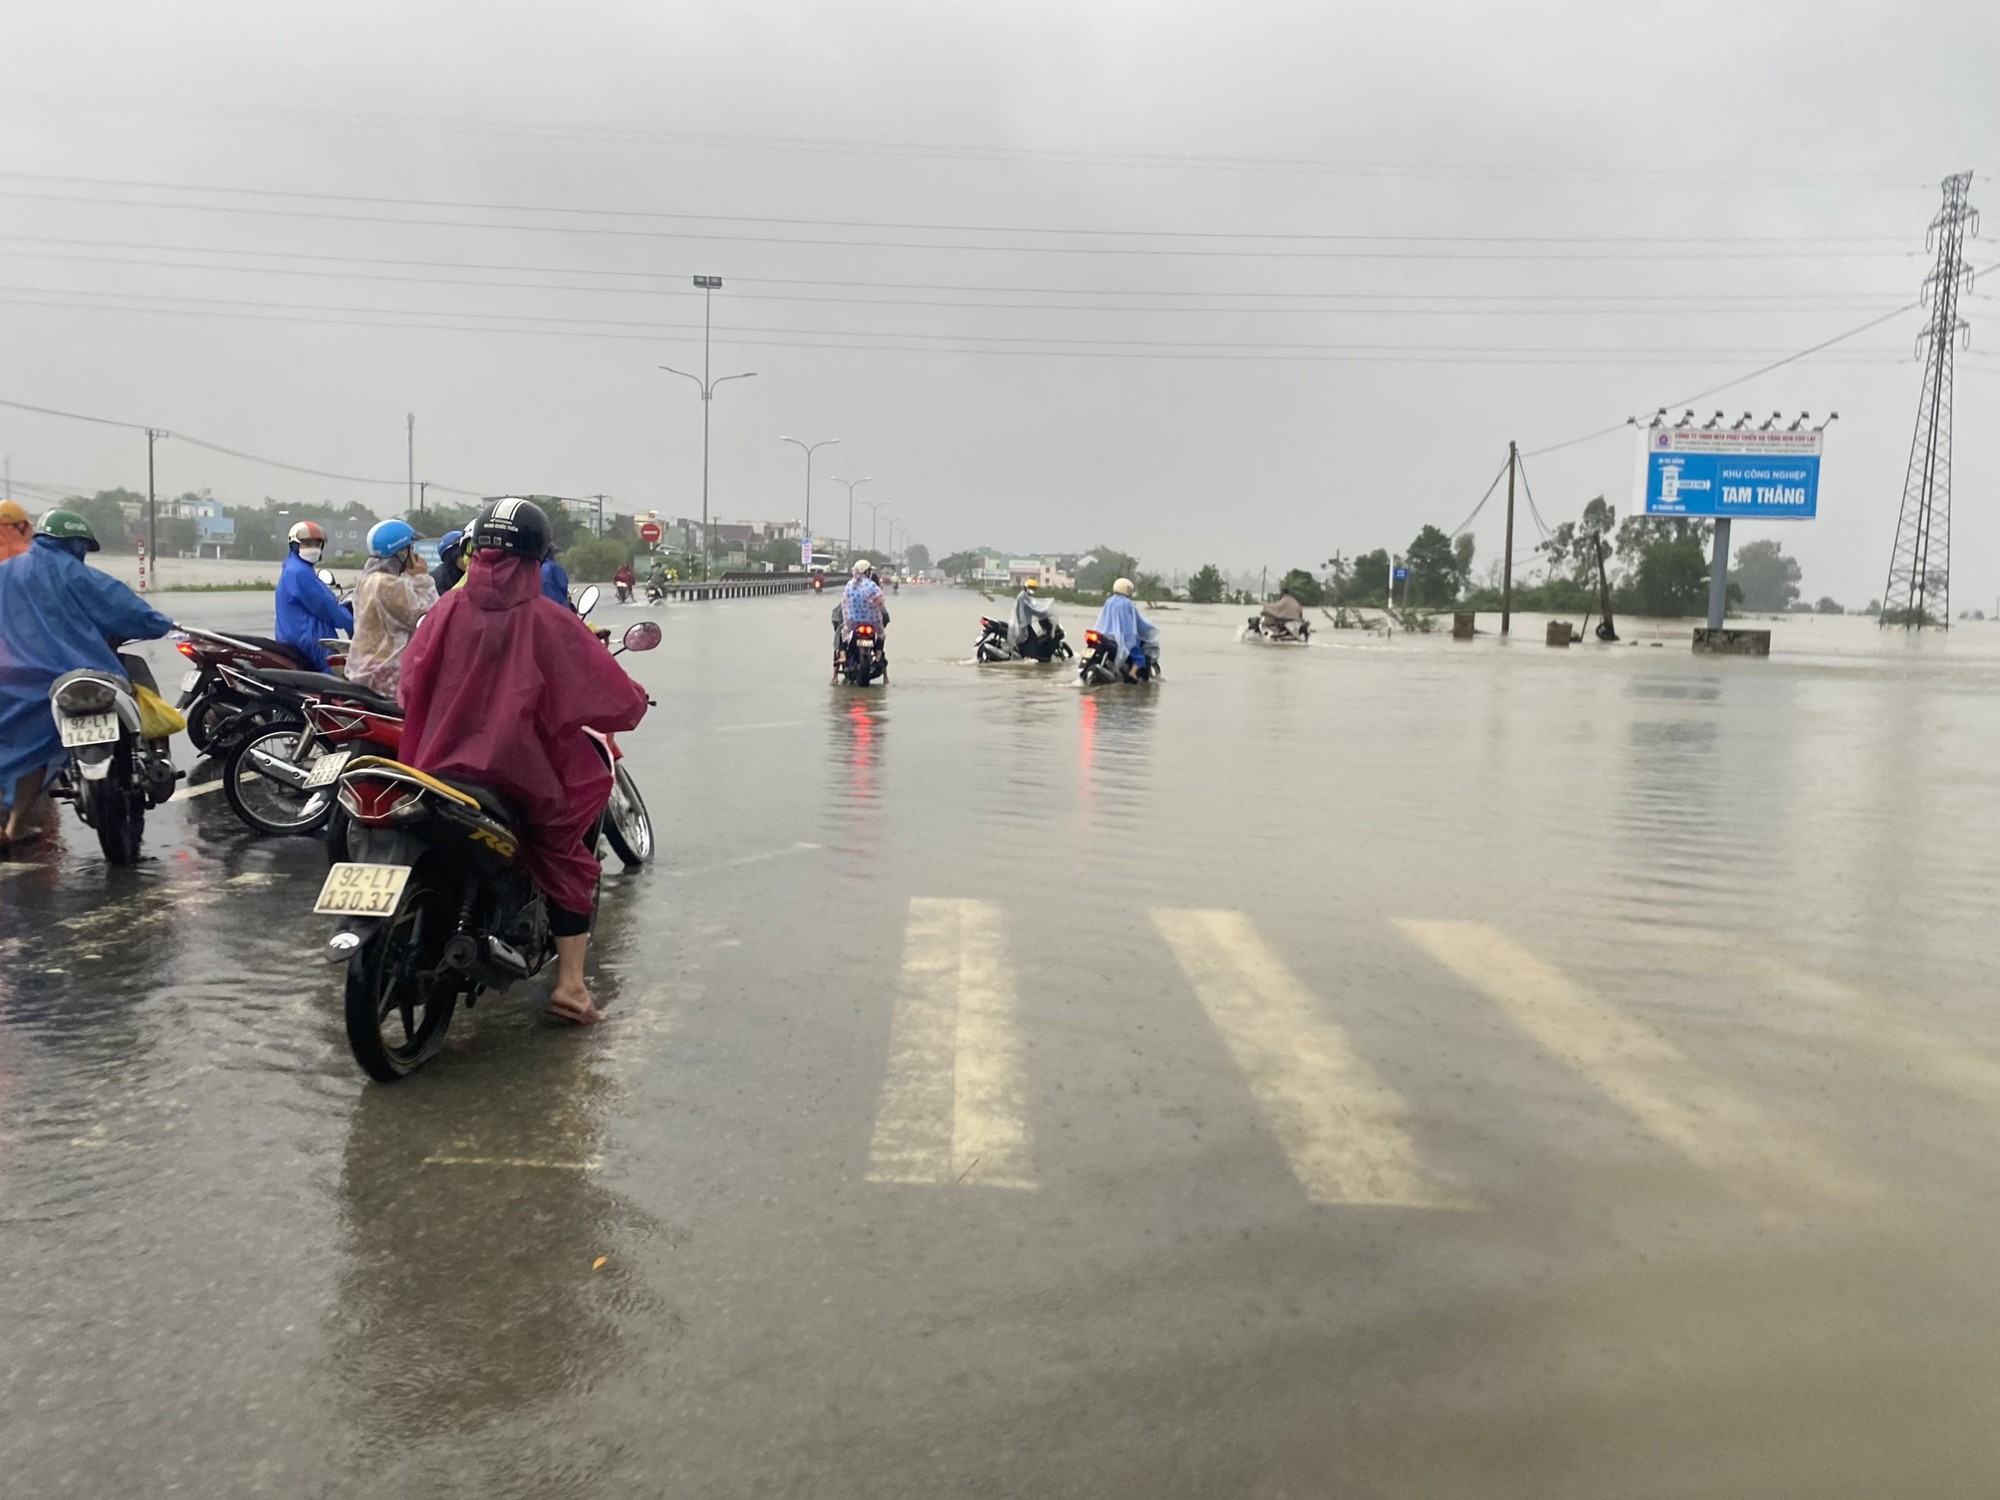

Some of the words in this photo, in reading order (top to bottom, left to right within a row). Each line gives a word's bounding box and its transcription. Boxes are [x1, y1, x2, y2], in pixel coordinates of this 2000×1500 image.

[1722, 470, 1742, 479] KHU
[1744, 468, 1770, 479] CÔNG
[1772, 470, 1806, 481] NGHIỆP
[1722, 486, 1752, 504] TAM
[1757, 483, 1805, 505] THĂNG
[71, 715, 108, 730] 92-L1
[66, 728, 116, 745] 142.42
[339, 866, 396, 889] 92-L1
[323, 890, 396, 913] 130.37
